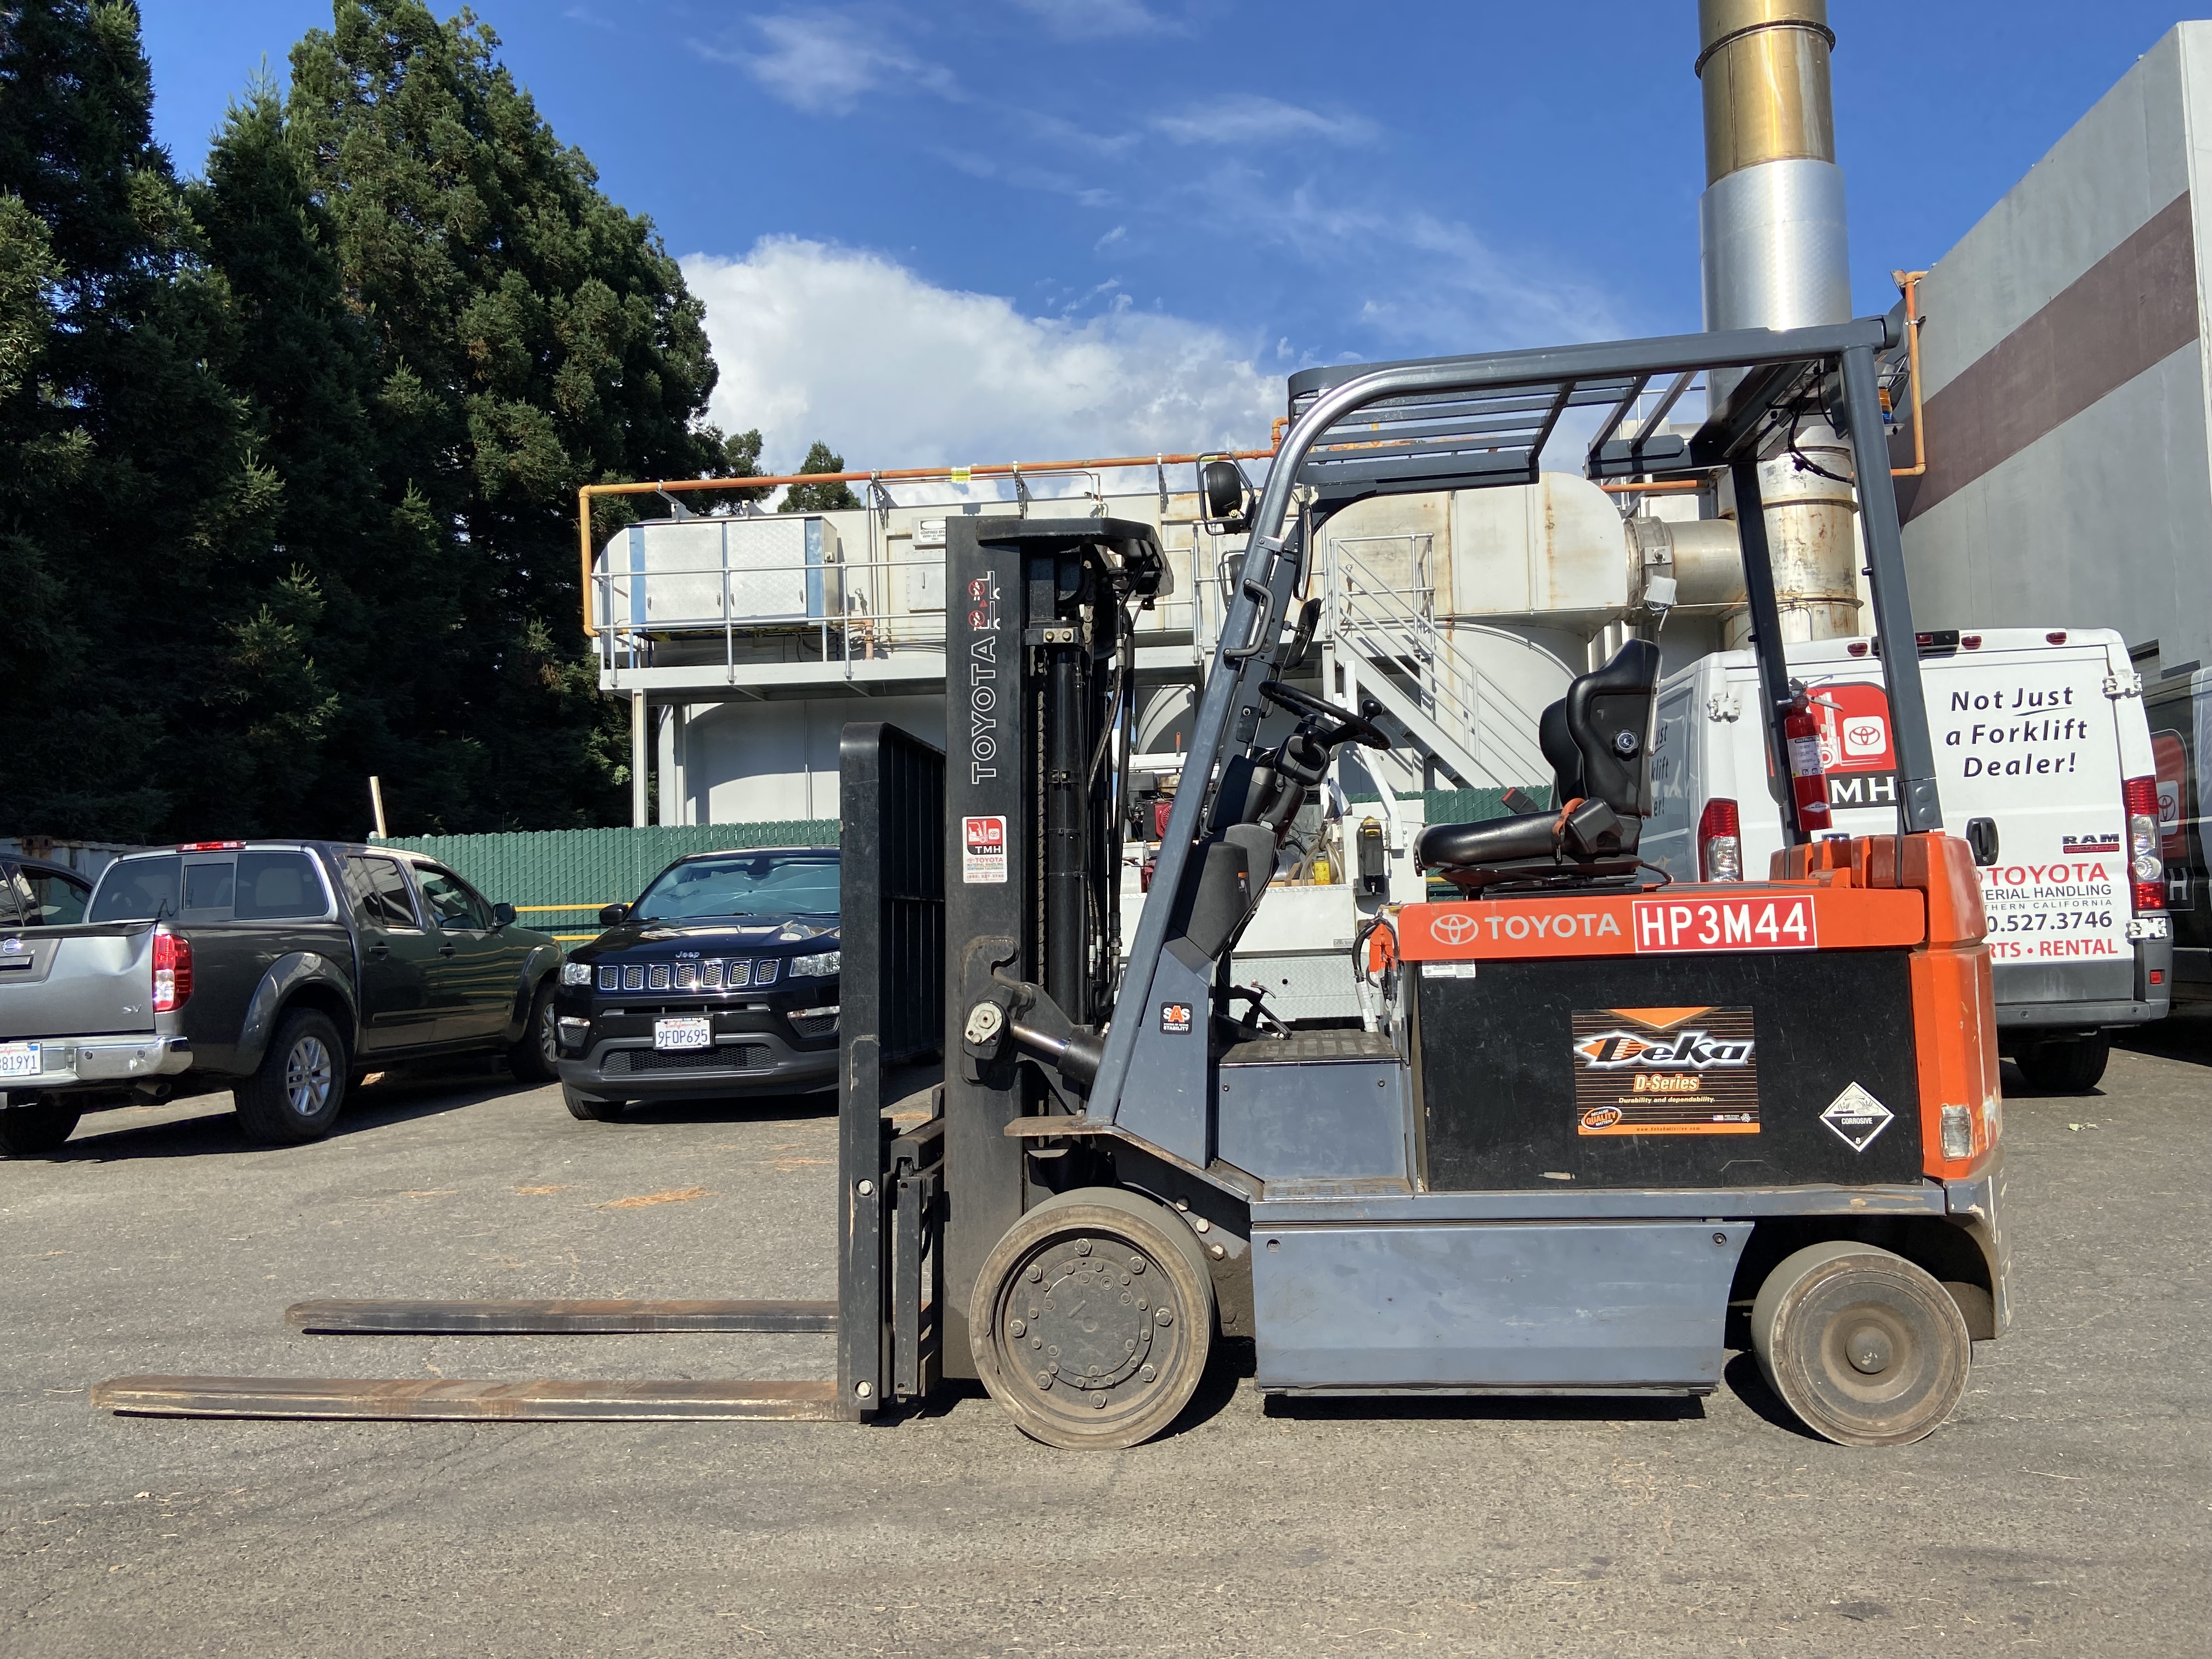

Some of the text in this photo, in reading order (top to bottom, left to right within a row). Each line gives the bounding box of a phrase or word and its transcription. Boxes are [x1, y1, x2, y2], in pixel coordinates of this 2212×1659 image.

[971, 635, 997, 785] TOYOTA
[1951, 686, 2073, 712] Not Just
[1655, 722, 1668, 746] ust
[1946, 718, 2087, 746] a Forklift
[1651, 755, 1668, 783] klift
[1963, 752, 2076, 777] Dealer!
[1829, 776, 1897, 804] MH
[975, 845, 1001, 854] TMH
[2062, 833, 2119, 844] RAM
[1987, 862, 2109, 886] TOYOTA
[1984, 884, 2112, 900] ERIAL HANDLING
[1984, 900, 2112, 911] THERN CALIFORNIA
[1484, 913, 1622, 940] TOYOTA
[1641, 902, 1808, 946] HP3M44
[1987, 910, 2112, 932] 0.527.3746
[1987, 939, 2118, 958] RTS RENTAL
[122, 1004, 142, 1014] SV
[1163, 1005, 1190, 1023] SAS
[1587, 1032, 1751, 1066] Deka
[0, 1055, 37, 1070] 819Y1
[1634, 1074, 1699, 1091] D-Series
[1586, 1111, 1616, 1125] QUALITY
